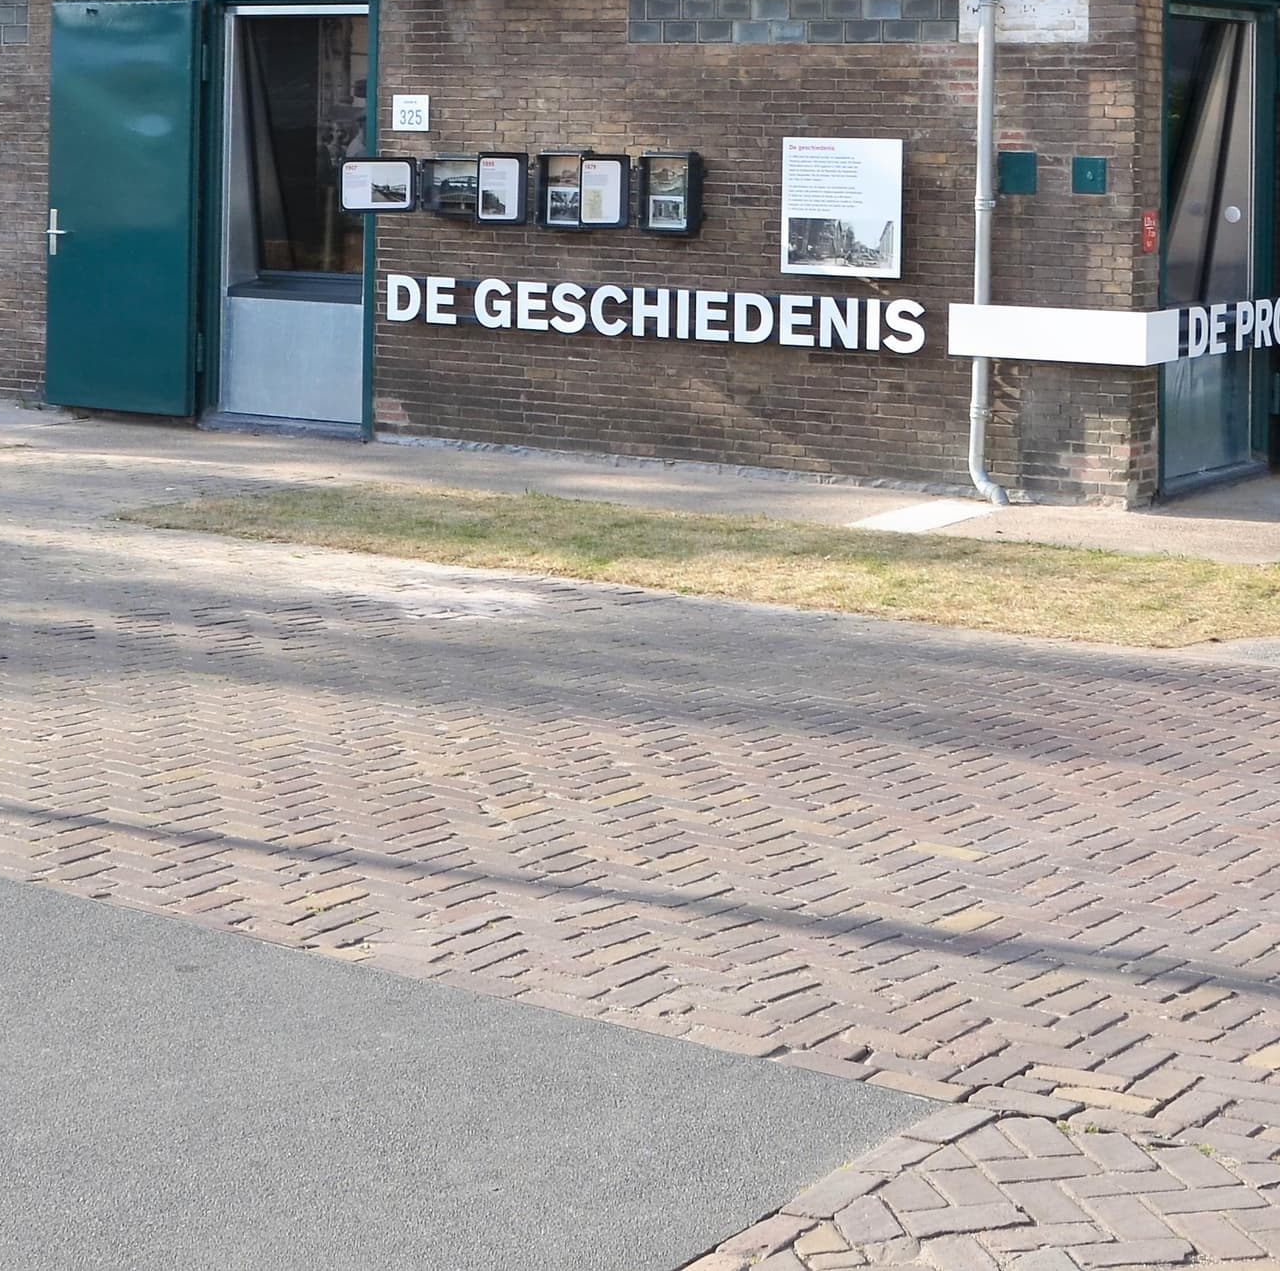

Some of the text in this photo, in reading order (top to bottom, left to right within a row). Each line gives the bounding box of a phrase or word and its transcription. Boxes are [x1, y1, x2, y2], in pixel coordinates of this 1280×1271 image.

[399, 109, 423, 126] 325
[387, 274, 926, 354] DE GESCHIEDENIS
[1188, 304, 1227, 358] DE
